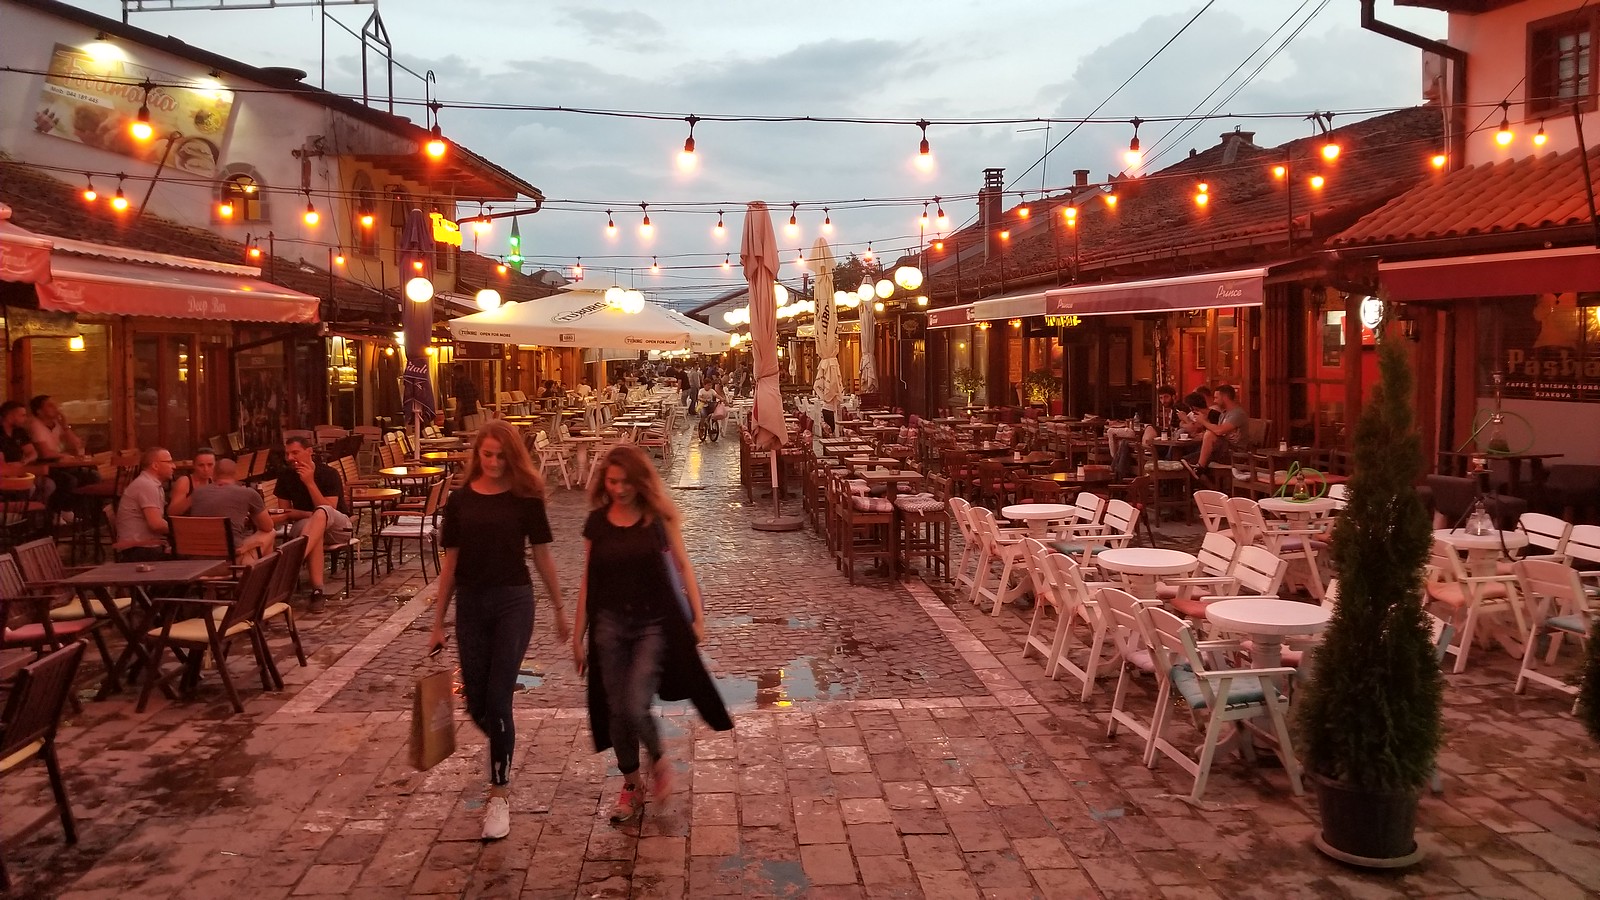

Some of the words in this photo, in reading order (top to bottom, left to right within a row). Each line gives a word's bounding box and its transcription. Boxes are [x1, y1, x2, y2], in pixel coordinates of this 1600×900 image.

[1216, 285, 1242, 299] Prince
[187, 295, 208, 316] Deep
[212, 296, 227, 313] Bar
